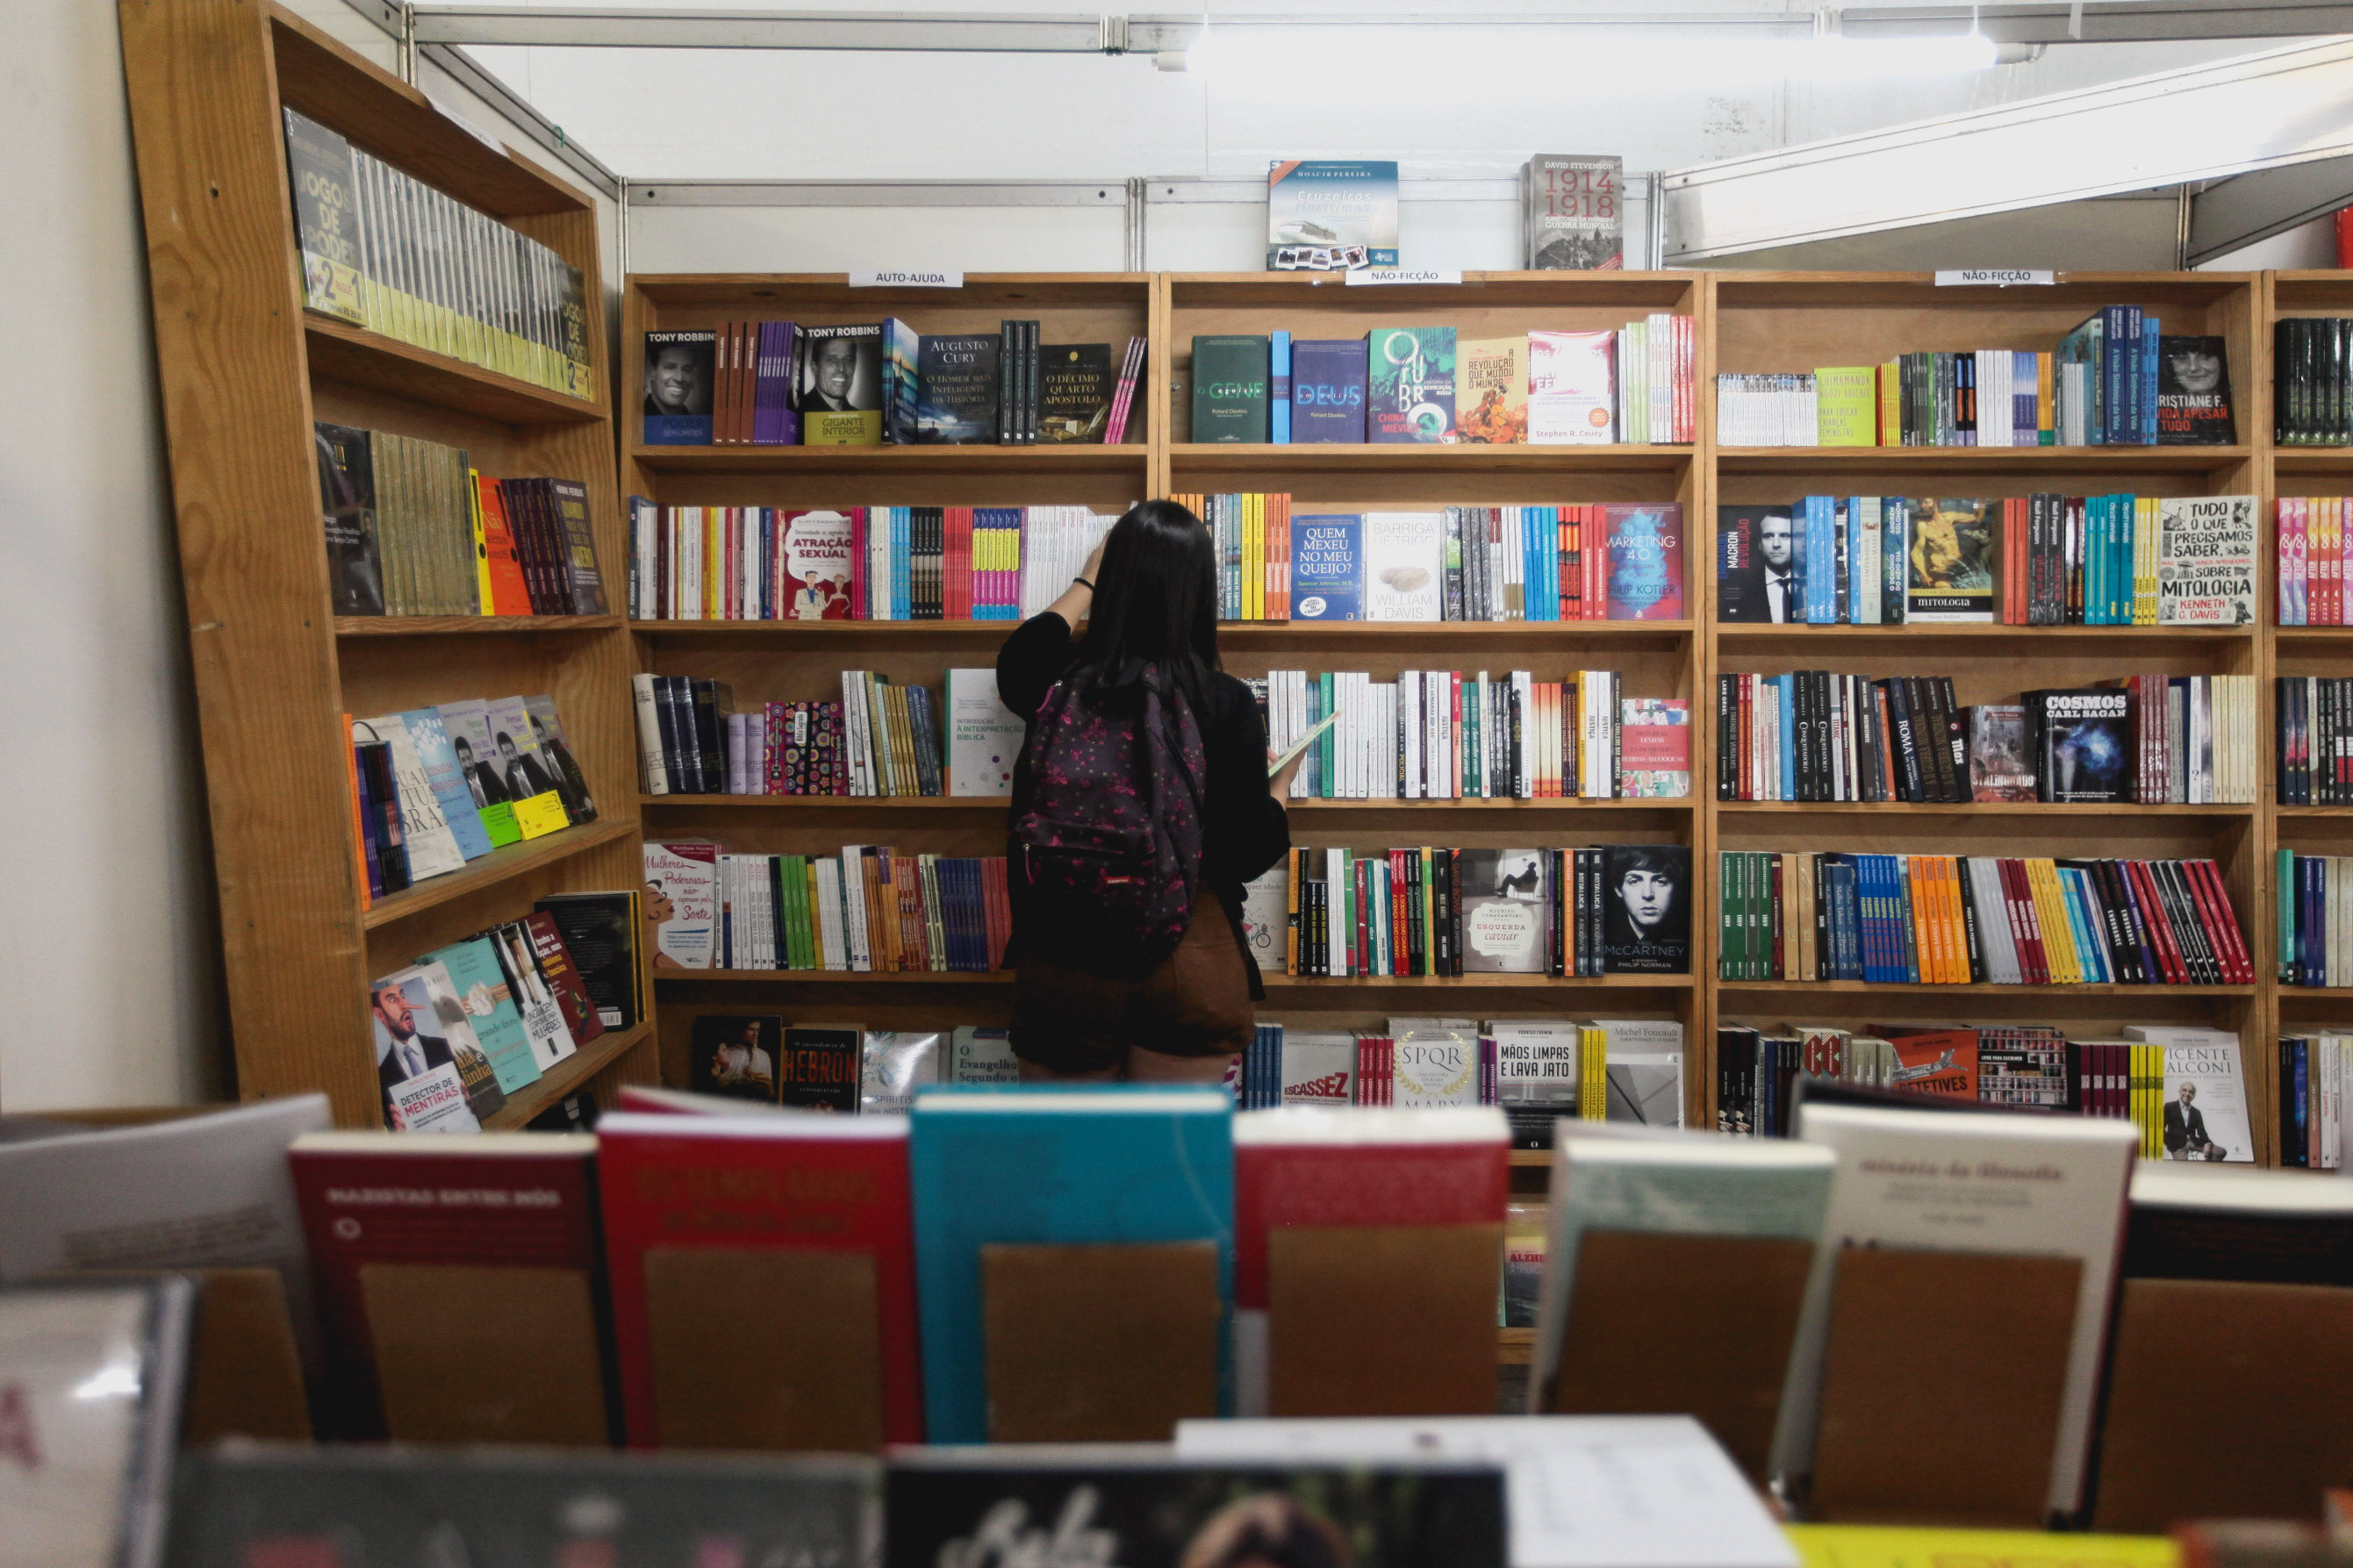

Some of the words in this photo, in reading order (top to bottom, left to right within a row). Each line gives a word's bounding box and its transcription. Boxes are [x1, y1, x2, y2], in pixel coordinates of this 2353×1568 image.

[1545, 170, 1614, 194] 1914
[1296, 190, 1371, 201] Cruzeiros
[1545, 195, 1614, 218] 1918
[319, 204, 340, 235] DE
[322, 261, 336, 300] 2
[876, 273, 945, 283] AUTO-AJUDA
[1371, 270, 1439, 282] NÃO-FICÇÃO
[1962, 271, 2031, 283] NÃO-FICÇÃO
[352, 273, 361, 310] 1
[649, 333, 675, 342] TONY
[808, 328, 834, 338] TONY
[836, 326, 880, 337] ROBBINS
[931, 340, 988, 352] AUGUSTO
[943, 354, 977, 364] CURY
[1468, 358, 1514, 370] REVOLUÇÃO
[1057, 373, 1100, 383] DÉCIMO
[1468, 370, 1483, 380] QUE
[1486, 368, 1514, 377] MUDOU
[1050, 385, 1095, 394] QUARTO
[1296, 384, 1360, 405] DEUS
[1044, 394, 1101, 405] APÓSTOLO
[2156, 395, 2213, 407] RISTIANE
[1378, 414, 1405, 423] CHINA
[2157, 409, 2177, 420] VIDA
[2180, 408, 2227, 419] APESAR
[822, 419, 864, 427] GIGANTE
[2162, 420, 2191, 432] TUDO
[822, 427, 864, 436] INTERIOR
[2190, 502, 2227, 516] TUDO
[1374, 522, 1435, 534] BARRIGA
[2191, 518, 2199, 530] O
[2204, 518, 2227, 530] QUE
[1307, 528, 1345, 540] QUEM
[2174, 531, 2252, 545] PRECISAMOS
[793, 536, 852, 548] ATRAÇÃO
[1303, 541, 1348, 550] MEXEU
[1605, 536, 1675, 548] MARKETING
[1739, 519, 1750, 569] REVOLUÇÃO
[799, 549, 847, 558] SEXUAL
[1300, 552, 1320, 562] NO
[1324, 552, 1352, 562] MEU
[1627, 548, 1650, 560] 4.0
[1727, 532, 1739, 569] MACRON
[2174, 544, 2223, 558] SABER,
[1300, 563, 1352, 576] QUEIJO?
[2195, 567, 2232, 577] SOBRE
[2308, 560, 2318, 579] AFTER
[2320, 560, 2330, 579] AFTER
[2162, 579, 2252, 598] MITOLOGIA
[1376, 594, 1432, 605] WILLIAM
[2180, 599, 2226, 609] KENNETH
[1384, 607, 1424, 619] DAVIS
[2179, 611, 2188, 620] C.
[2190, 611, 2220, 619] DAVIS
[2046, 696, 2127, 710] COSMOS
[1898, 720, 1908, 755] ROMA
[1799, 721, 1808, 773] CONQUISTADORES
[1819, 721, 1827, 773] CONQUISTADORES
[1951, 738, 1964, 765] Max
[646, 856, 698, 869] Mulheres
[664, 871, 710, 885] Poderosas
[1452, 888, 1460, 914] BOWIE
[682, 905, 713, 920] Sorte
[2027, 900, 2036, 921] NEGÓCIOS
[2031, 922, 2041, 940] DIGITAIS
[2107, 909, 2122, 947] ENDURANCE
[2120, 909, 2136, 946] ENDURANCE
[1484, 931, 1519, 942] caviar
[1604, 945, 1685, 956] McCARTNEY
[532, 1020, 562, 1042] MULHERES
[1614, 1027, 1642, 1037] Michel
[1644, 1027, 1678, 1037] Foucault
[960, 1045, 969, 1055] O
[1501, 1044, 1529, 1060] MÃOS
[1533, 1046, 1569, 1060] LIMPAS
[2163, 1048, 2229, 1061] VICENTE
[958, 1058, 1017, 1071] Evangelho
[1402, 1046, 1464, 1072] SPQR
[783, 1050, 857, 1084] HEBRON
[1501, 1062, 1507, 1076] E
[1510, 1062, 1538, 1077] LAVA
[1542, 1062, 1569, 1078] JATO
[958, 1071, 1008, 1085] Segundo
[1010, 1073, 1018, 1082] o
[400, 1082, 441, 1106] DETECTOR
[442, 1077, 454, 1087] DE
[1284, 1072, 1348, 1098] ESCASSEZ
[1899, 1076, 1968, 1094] DETETIVES
[404, 1085, 459, 1117] MENTIRAS
[439, 1188, 507, 1206] ENTRE
